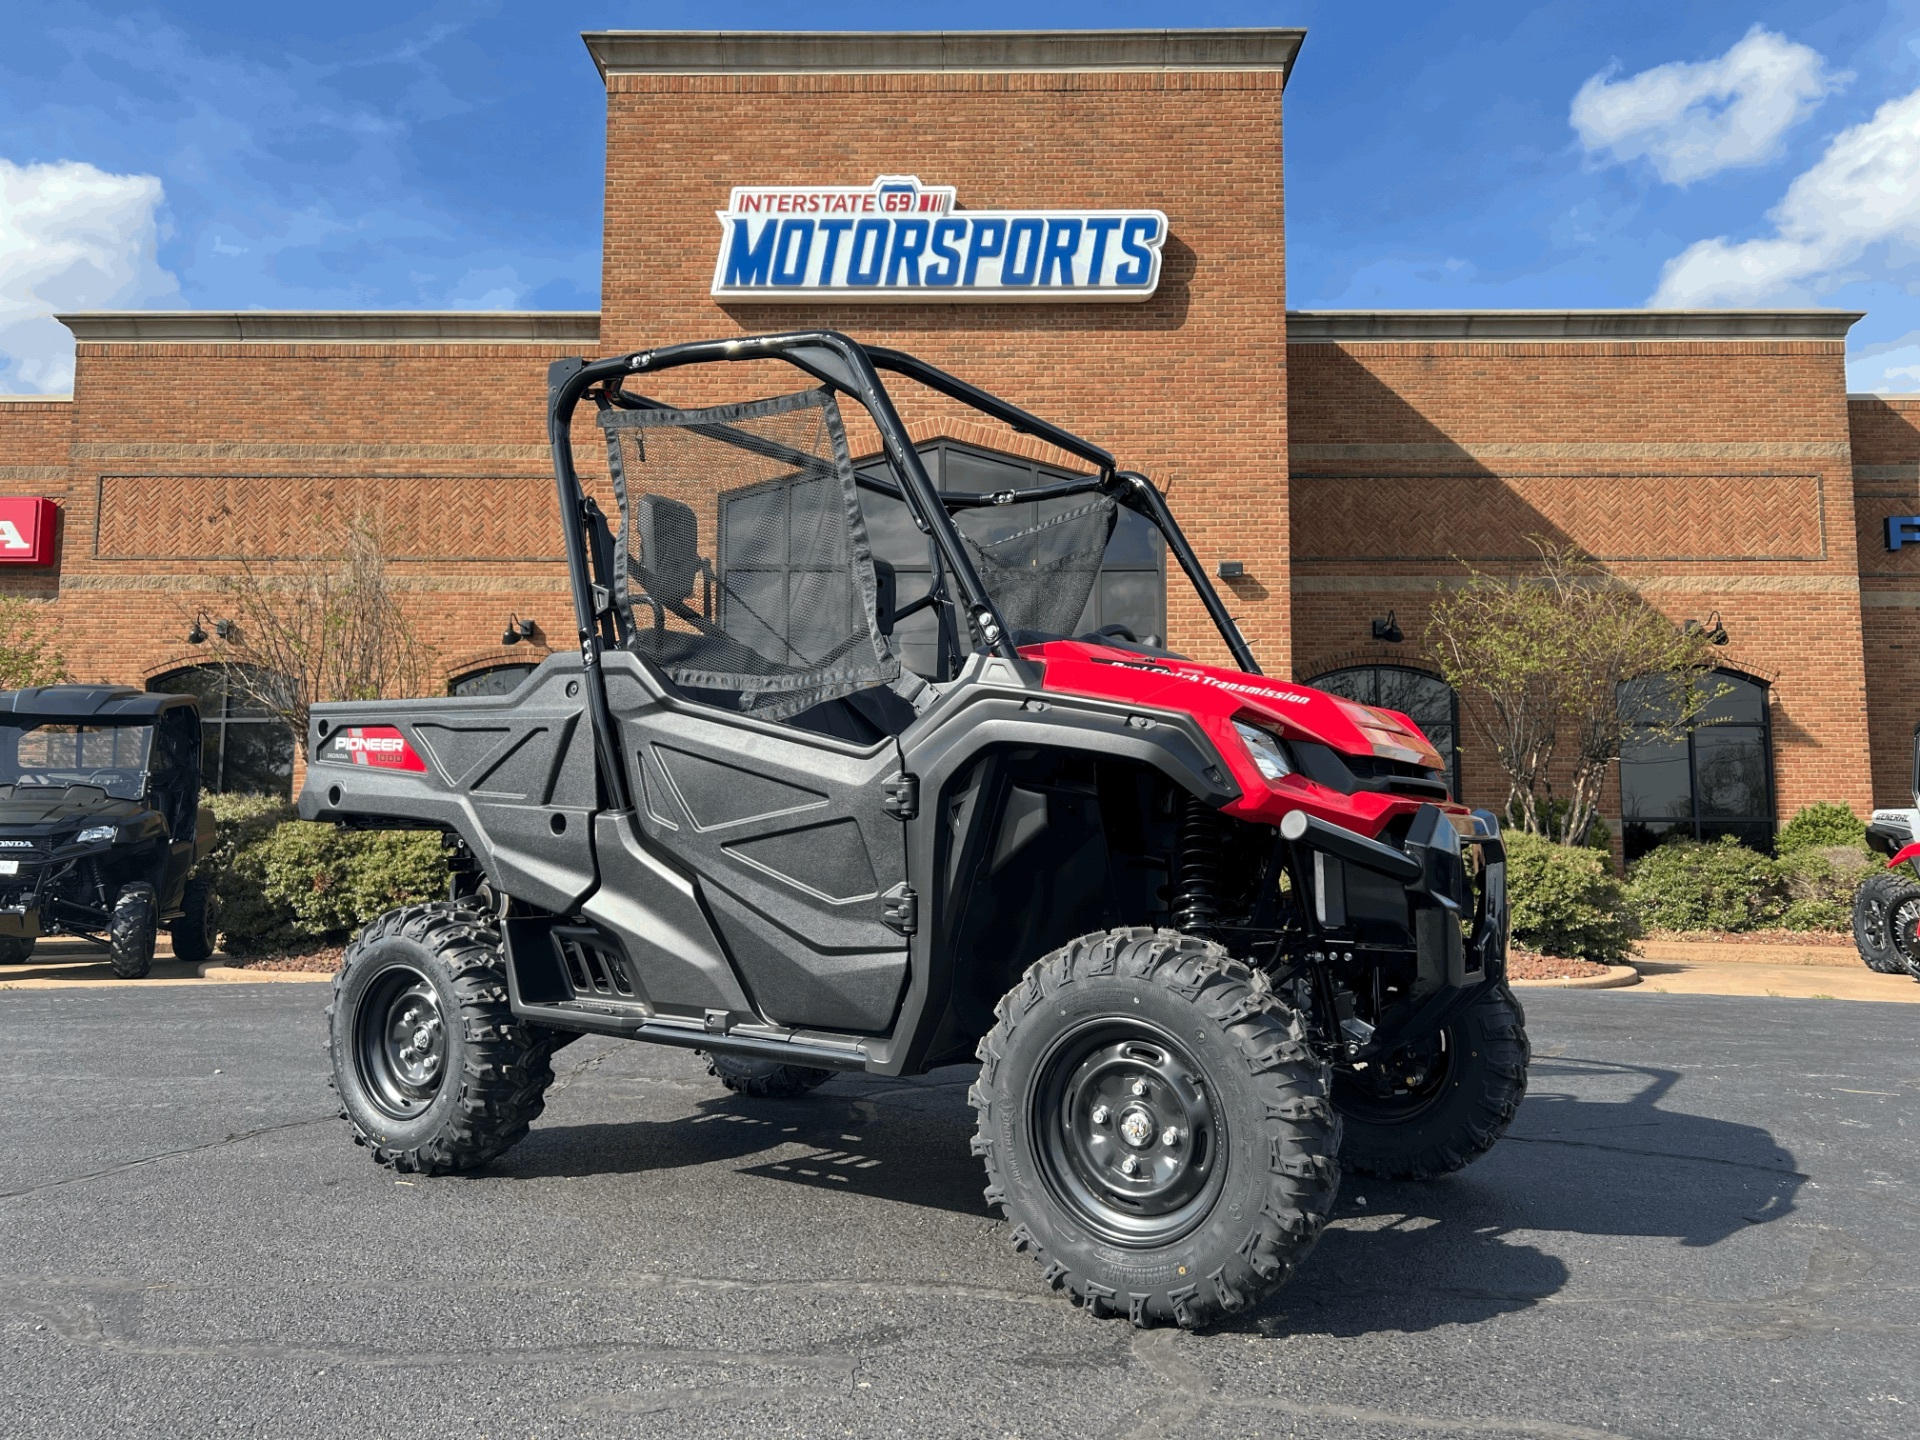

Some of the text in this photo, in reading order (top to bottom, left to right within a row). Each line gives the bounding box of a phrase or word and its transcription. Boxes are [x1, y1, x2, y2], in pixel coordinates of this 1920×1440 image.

[738, 193, 912, 213] INTERSTATE 69
[727, 218, 1160, 286] MOTORSPORTS
[1202, 676, 1310, 705] Transmission
[335, 737, 404, 751] PIONEER
[375, 753, 403, 763] 1000
[1876, 813, 1909, 822] GENERAL
